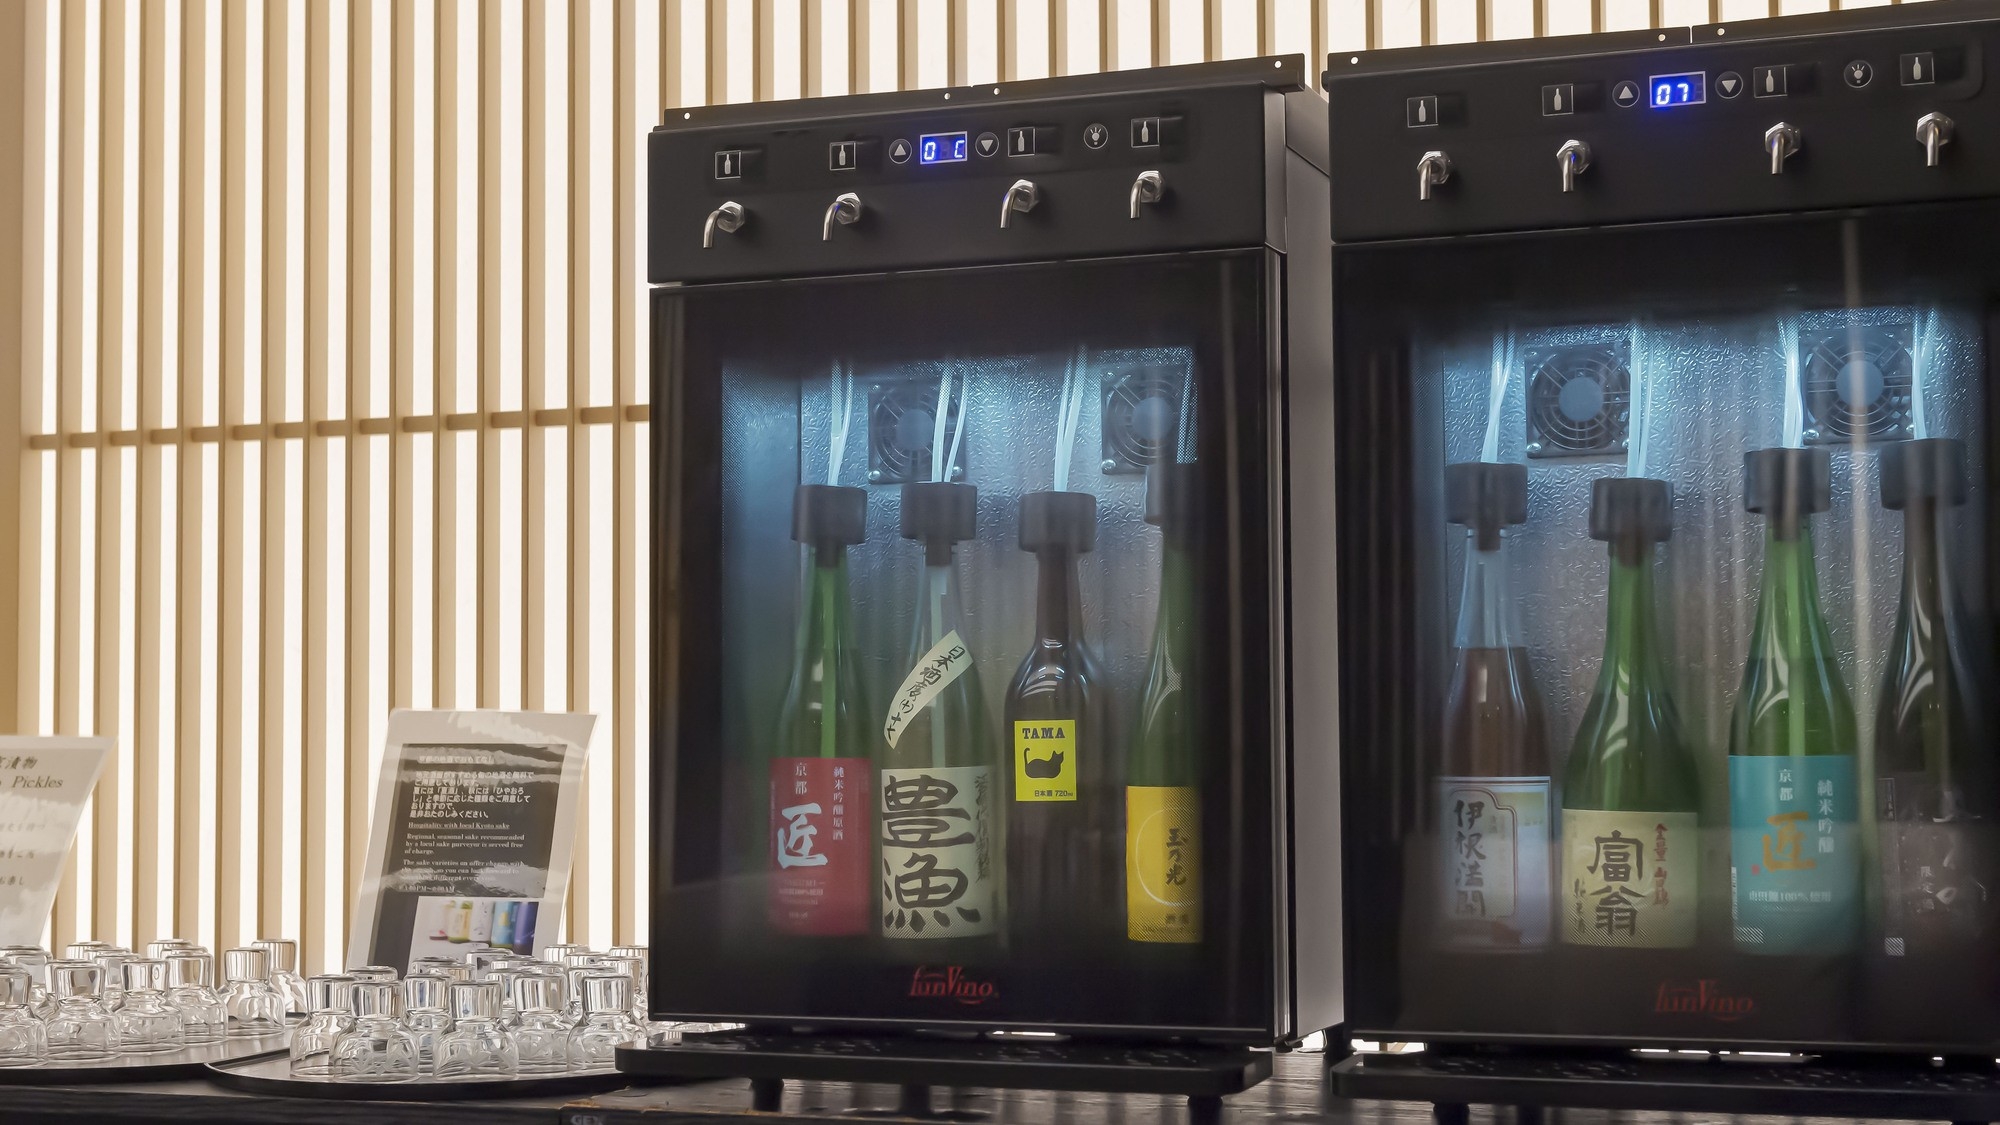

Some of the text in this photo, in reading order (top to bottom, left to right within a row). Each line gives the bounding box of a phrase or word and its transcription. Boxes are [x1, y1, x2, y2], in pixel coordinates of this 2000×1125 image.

[1656, 83, 1689, 105] 07
[1022, 727, 1066, 739] TAMA
[12, 775, 64, 789] Pickles
[794, 763, 808, 796] 京都
[1778, 769, 1793, 801] 京都
[832, 766, 845, 841] 純米吟醸原酒
[1817, 780, 1834, 853] 純米吟醸
[778, 803, 828, 869] 匠
[1762, 811, 1817, 873] 匠
[1586, 830, 1646, 937] 富翁
[909, 964, 993, 1004] funVino
